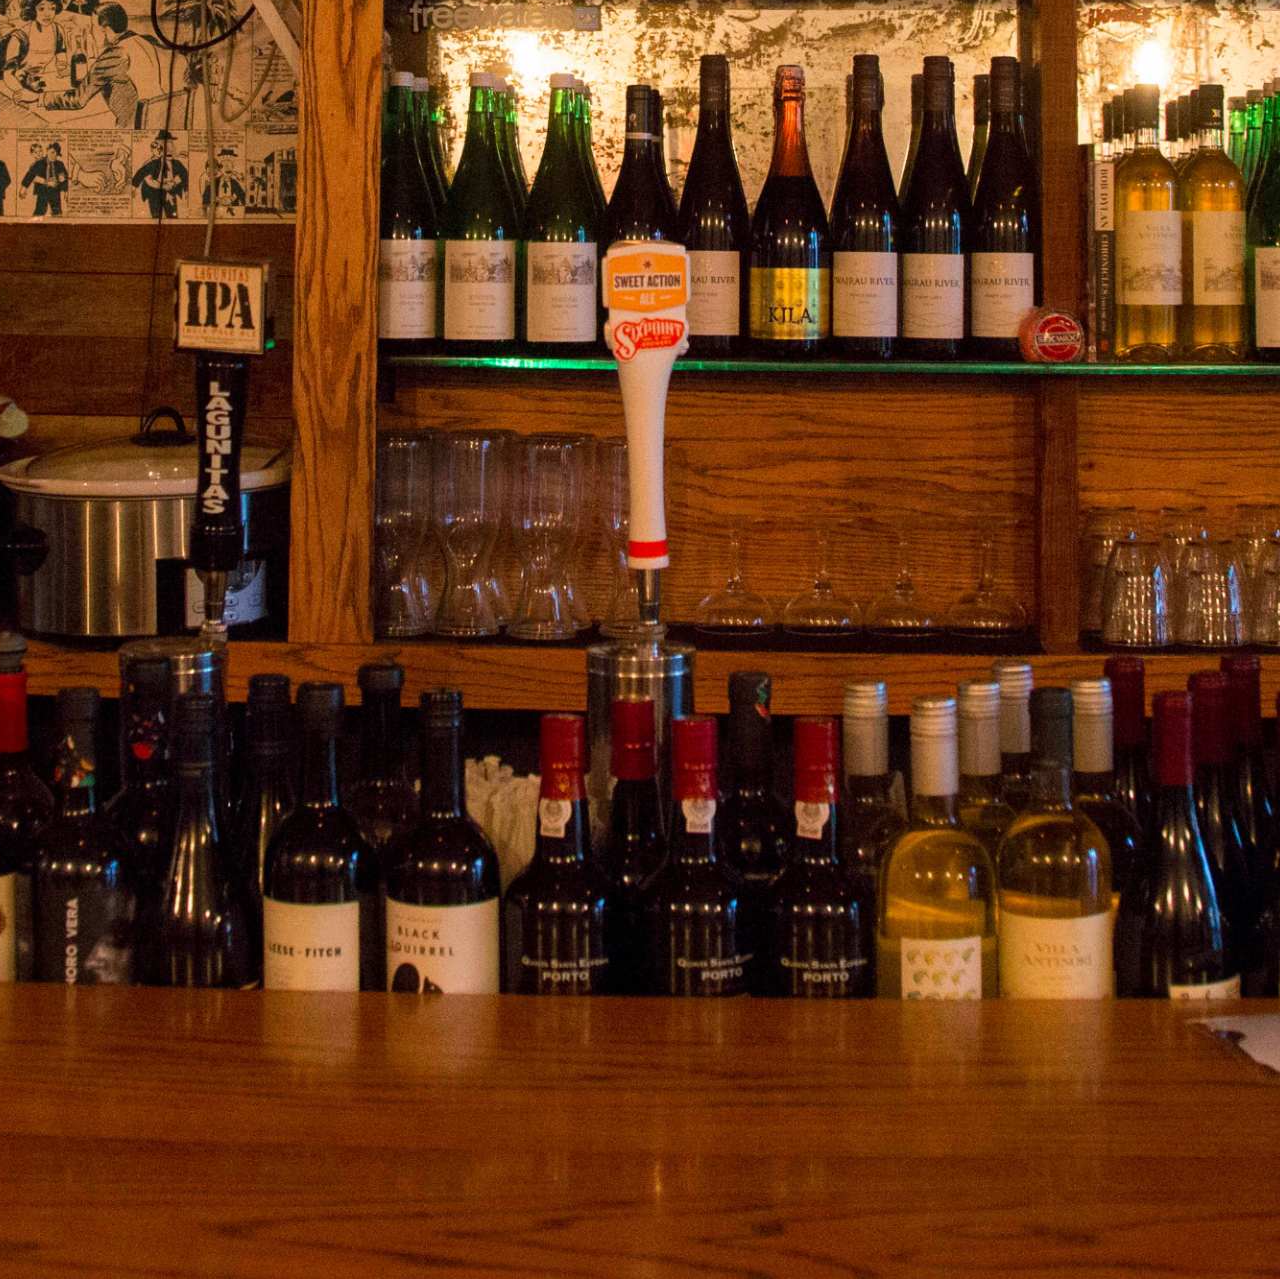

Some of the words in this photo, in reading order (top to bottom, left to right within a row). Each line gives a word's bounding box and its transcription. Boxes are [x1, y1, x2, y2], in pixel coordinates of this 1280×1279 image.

[614, 274, 645, 289] SWEET
[648, 273, 681, 288] ACTION
[710, 275, 736, 284] RIVER
[870, 277, 895, 287] RIVER
[934, 279, 960, 289] RIVER
[1005, 278, 1030, 287] RIVER
[184, 280, 255, 329] IPA
[640, 292, 656, 305] ALE
[201, 380, 233, 516] LAGUNITAS
[65, 897, 79, 938] VERA
[398, 926, 440, 940] BLACK
[542, 970, 590, 982] PORTO
[701, 966, 743, 981] PORTO
[802, 971, 850, 983] PORTO
